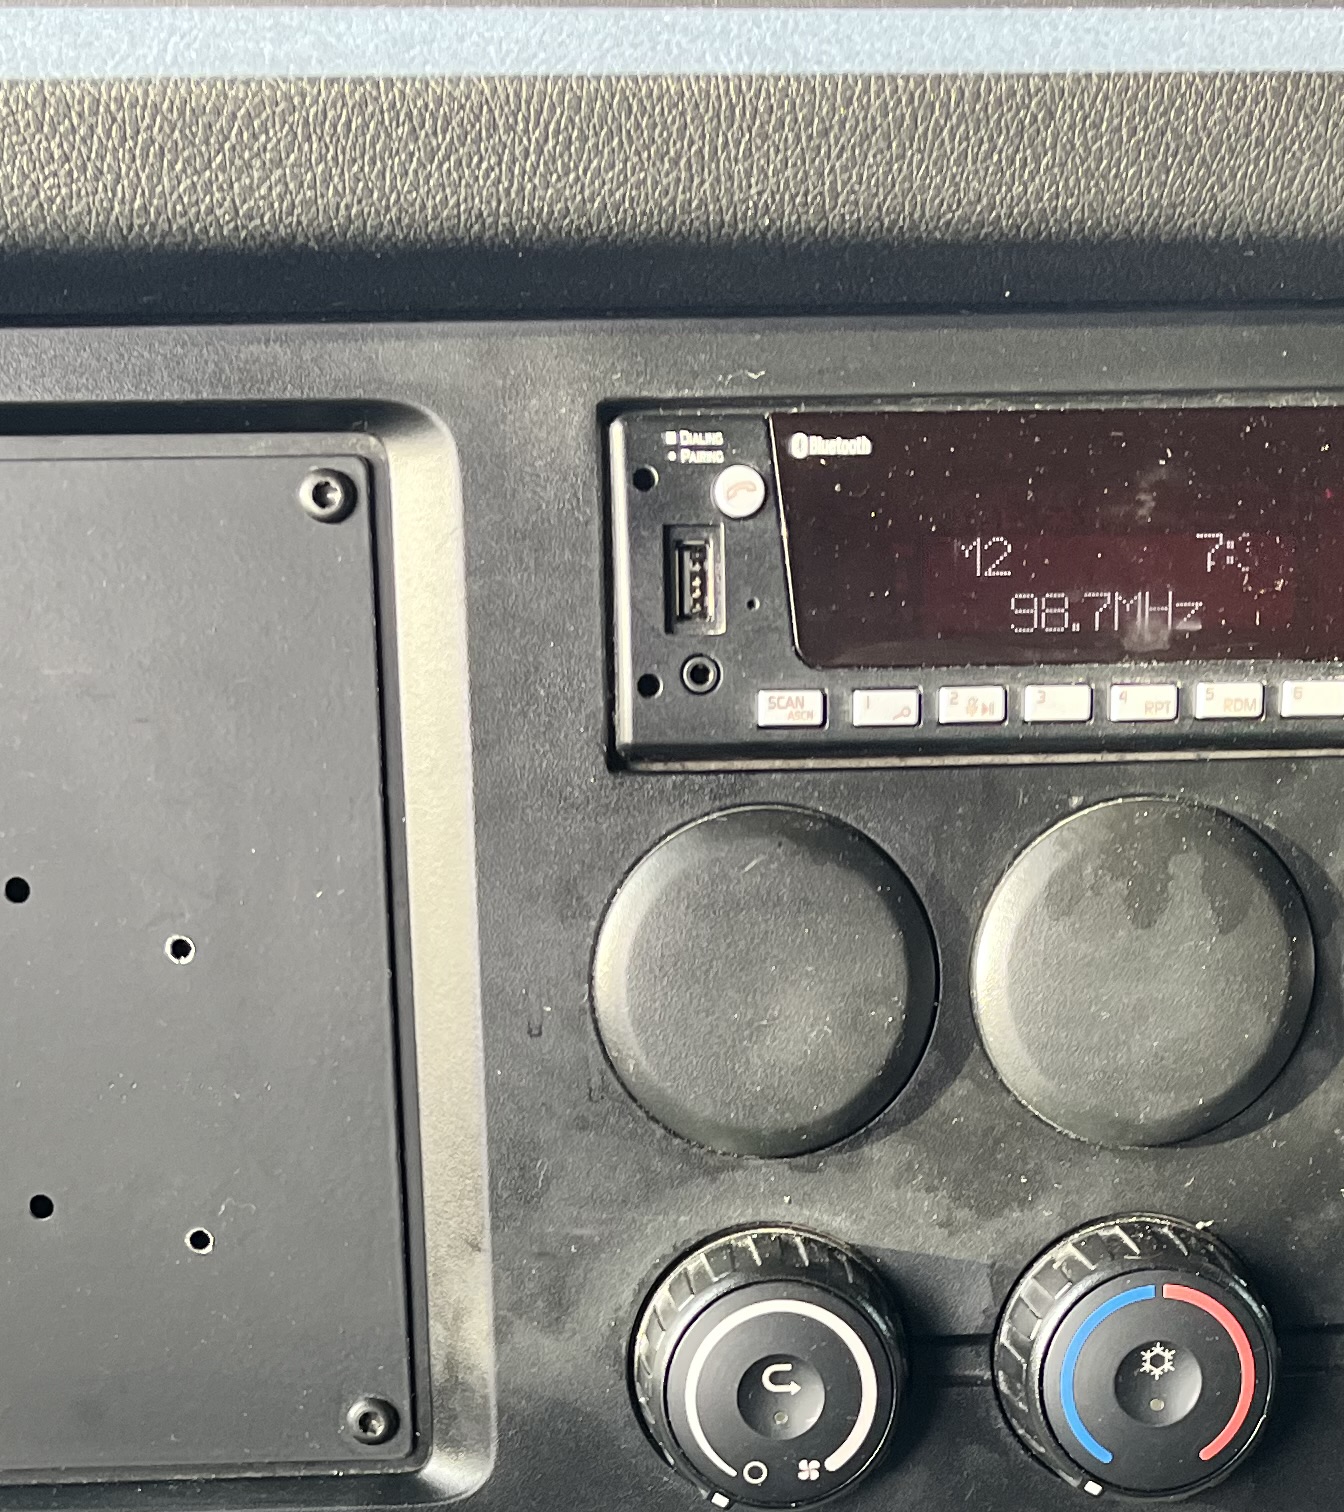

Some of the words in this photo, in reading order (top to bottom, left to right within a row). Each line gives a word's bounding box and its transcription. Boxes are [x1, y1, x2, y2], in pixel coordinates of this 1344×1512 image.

[679, 429, 724, 446] DIALING
[808, 434, 872, 456] Bluetooth
[680, 448, 725, 464] PAIRING
[1010, 590, 1204, 634] 98.7MHz
[950, 691, 959, 705] 2
[1036, 690, 1046, 704] 3
[1119, 690, 1128, 704] 4
[1205, 687, 1215, 701] 5
[1293, 686, 1303, 700] 6
[768, 695, 805, 710] SCAN
[1145, 700, 1172, 715] RPT
[1223, 697, 1257, 712] RDM
